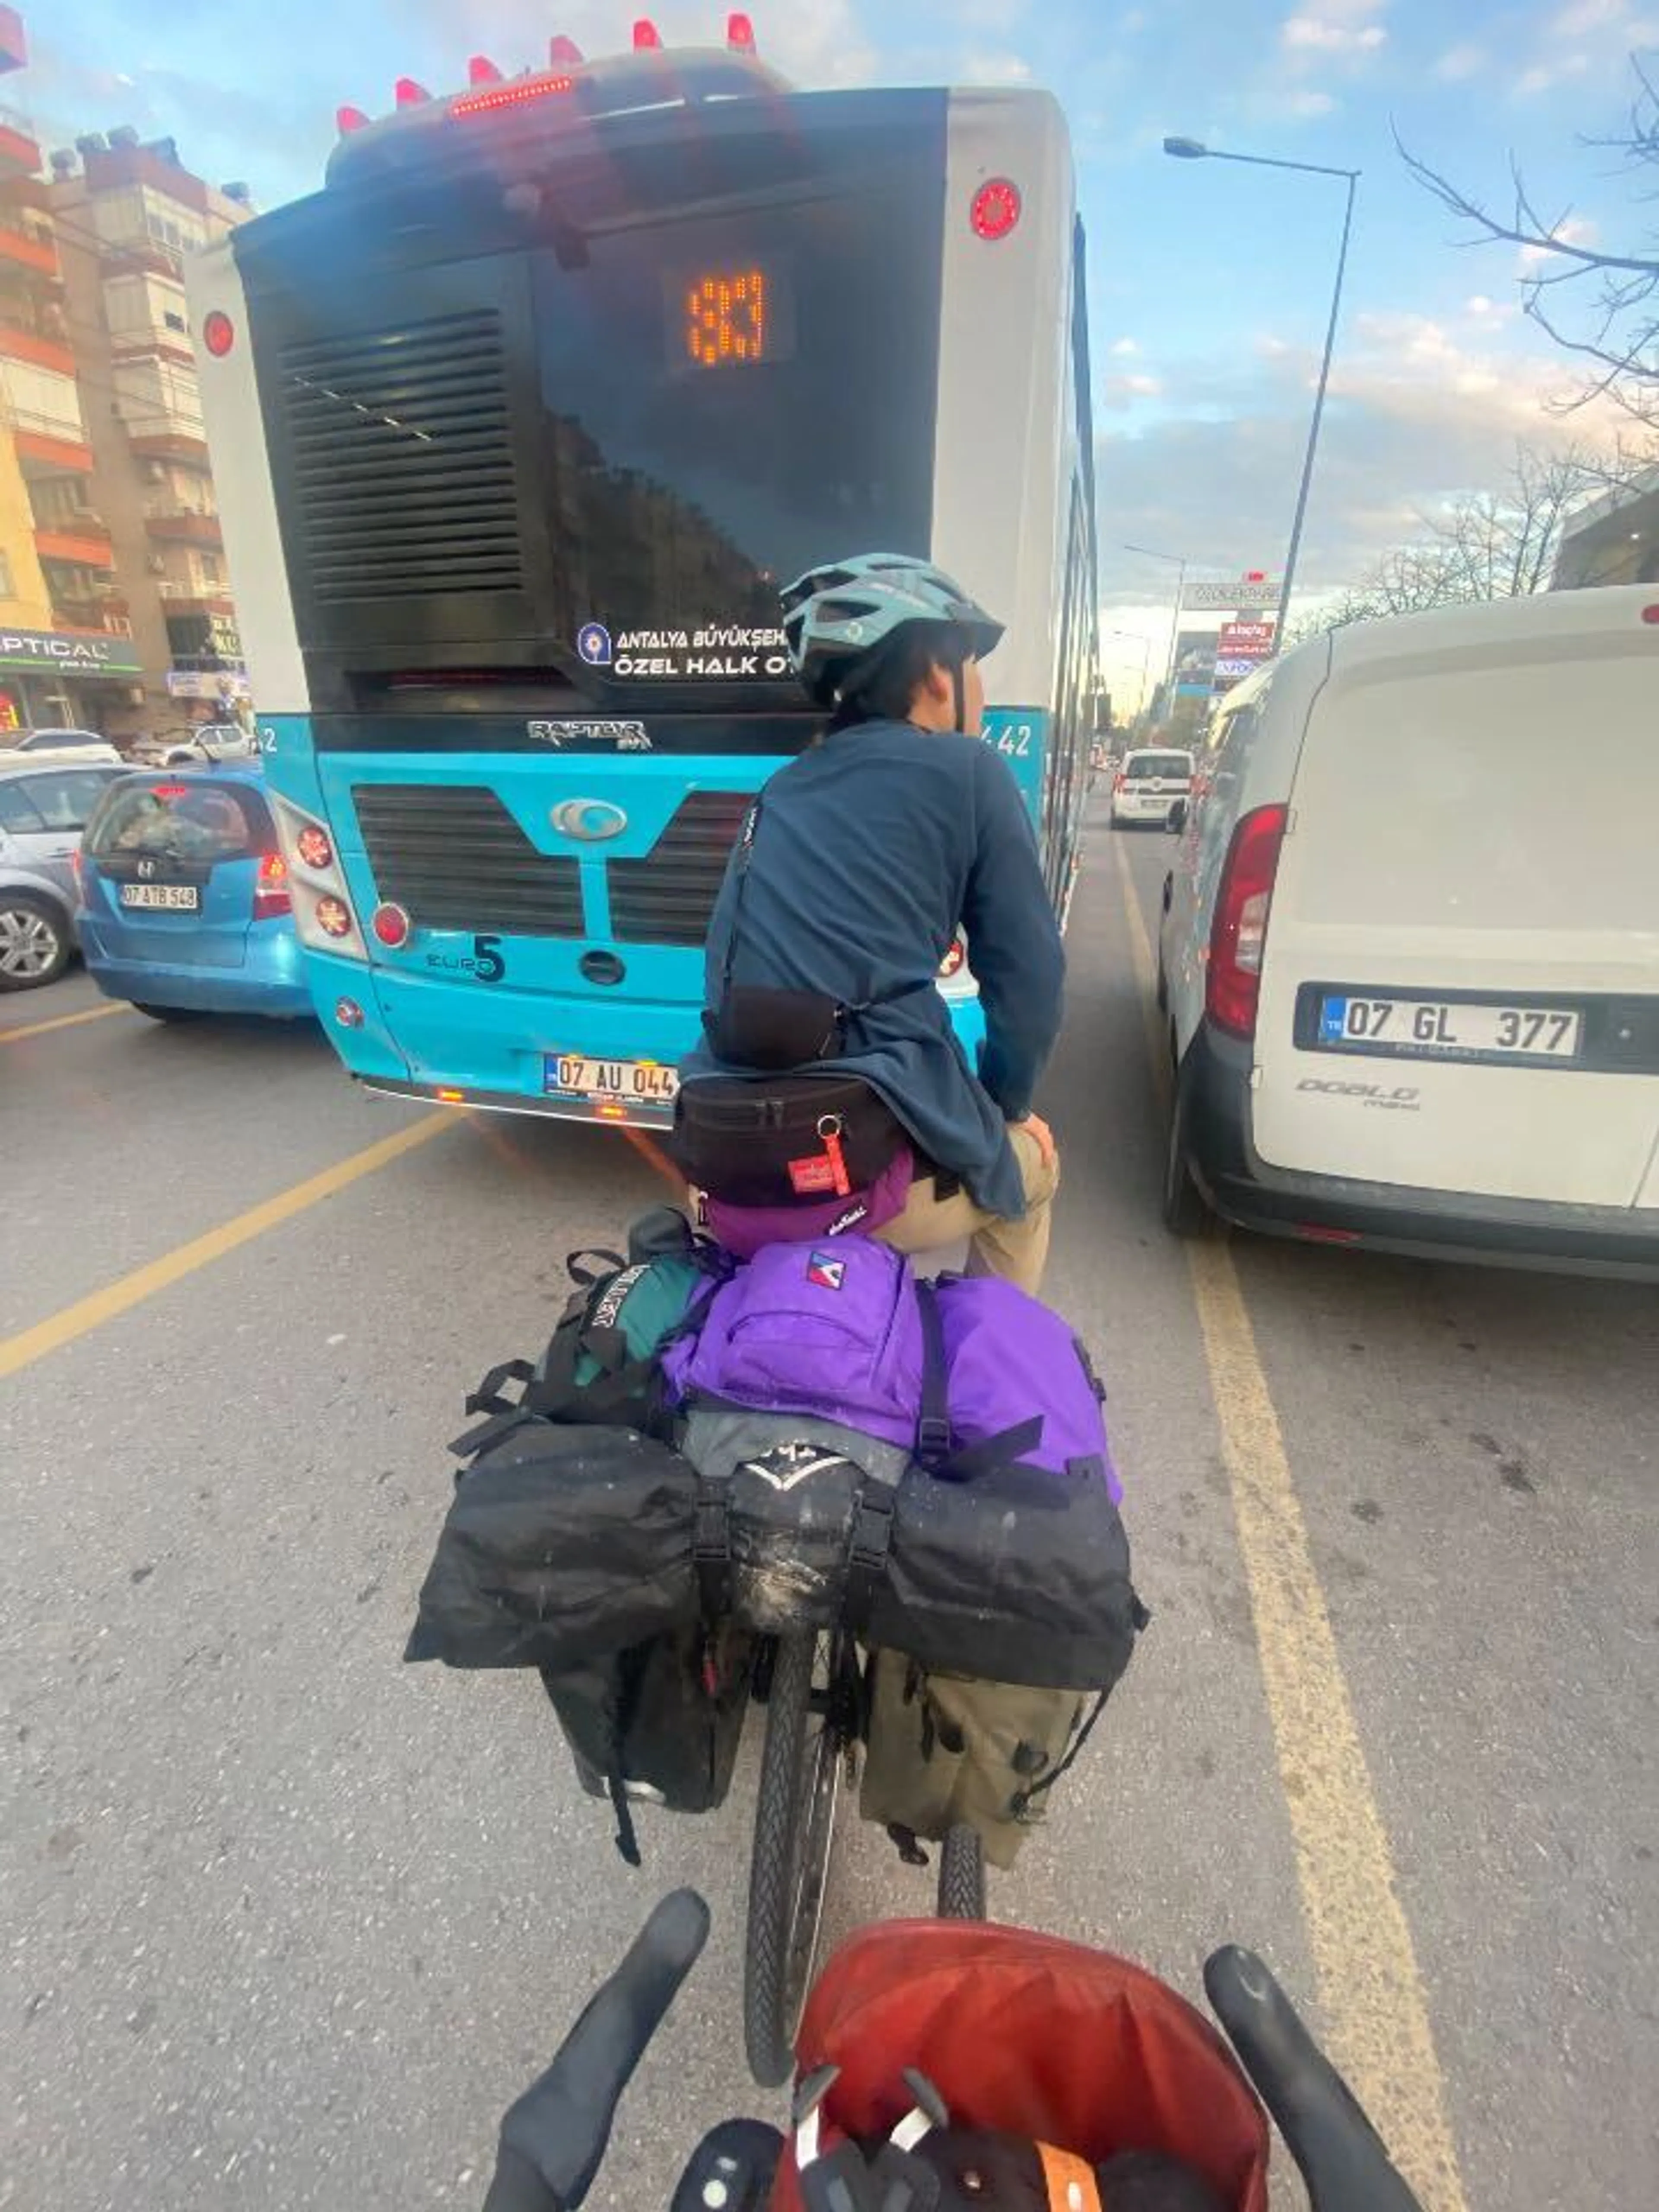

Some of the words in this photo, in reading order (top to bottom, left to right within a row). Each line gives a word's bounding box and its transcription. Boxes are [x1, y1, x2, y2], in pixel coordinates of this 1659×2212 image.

[0, 637, 109, 660] PTICAL
[617, 630, 688, 648] ANTALYA
[693, 624, 788, 652] BÜYÜKŞEH
[614, 655, 678, 674] ÖZEL
[686, 656, 759, 674] HALK
[764, 656, 794, 674] O
[259, 728, 277, 752] 2
[426, 953, 496, 975] EURO
[474, 935, 506, 983] 5
[1348, 1001, 1393, 1038] 07
[1413, 1006, 1457, 1042] GL
[1496, 1011, 1573, 1051] 377
[559, 1060, 585, 1087] 07
[596, 1064, 621, 1091] AU
[633, 1068, 674, 1096] 044
